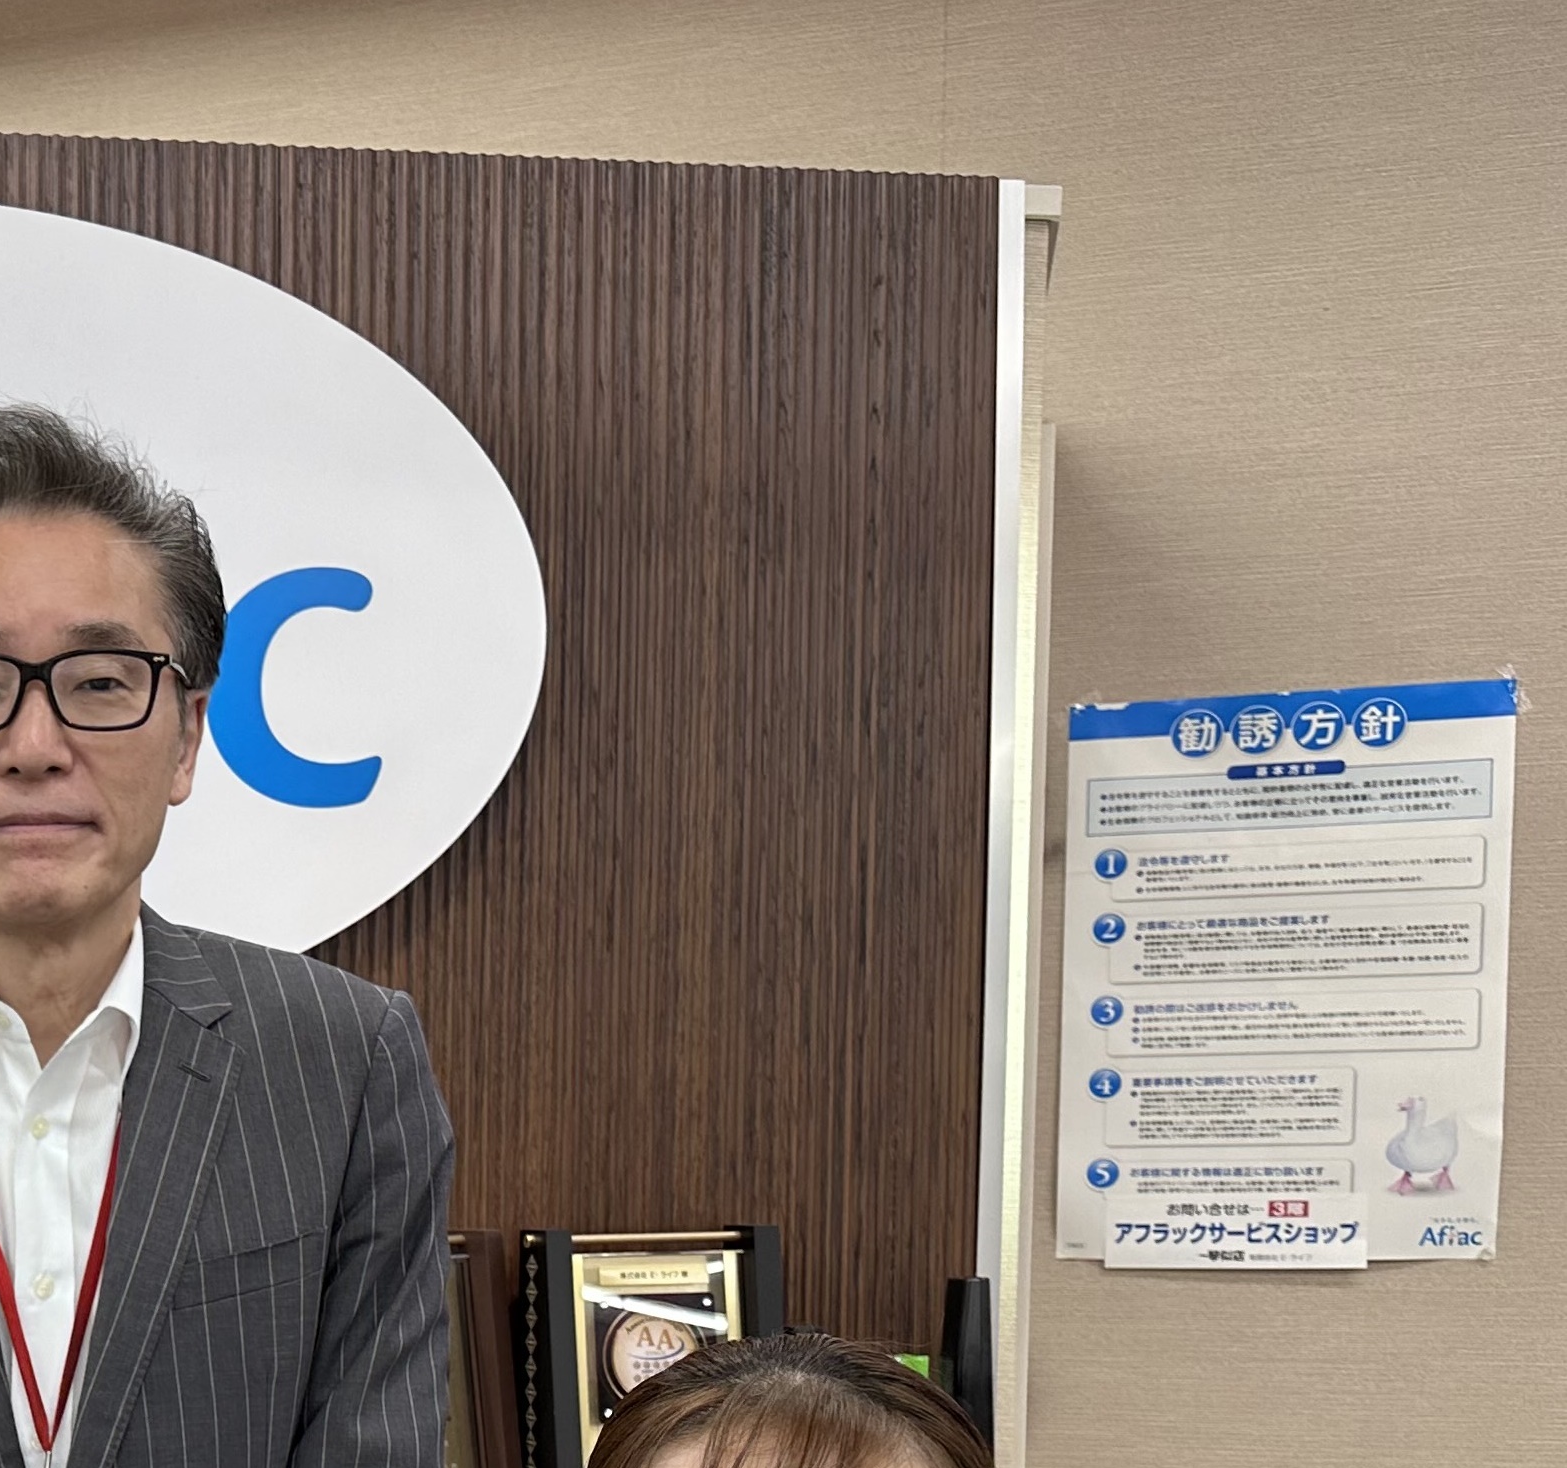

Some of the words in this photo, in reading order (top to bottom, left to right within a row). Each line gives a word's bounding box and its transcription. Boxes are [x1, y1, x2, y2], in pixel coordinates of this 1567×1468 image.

[1178, 704, 1401, 753] 勧誘方針
[1104, 855, 1117, 873] 1
[1102, 919, 1118, 938] 2
[1100, 1003, 1116, 1021] 3
[1095, 1075, 1112, 1095] 4
[1095, 1164, 1111, 1182] 5
[1114, 1220, 1361, 1246] アフラックサービスショップ
